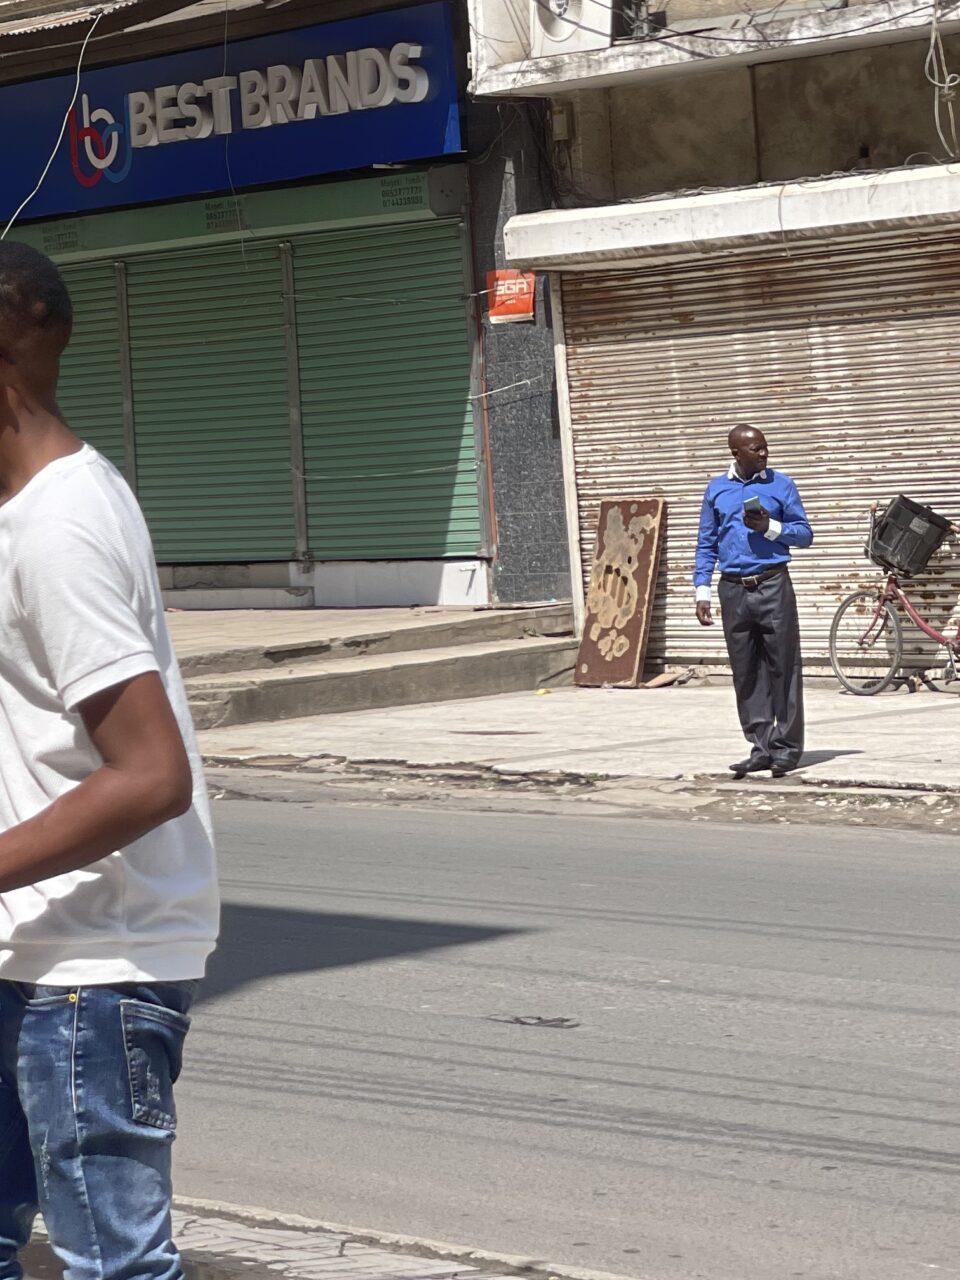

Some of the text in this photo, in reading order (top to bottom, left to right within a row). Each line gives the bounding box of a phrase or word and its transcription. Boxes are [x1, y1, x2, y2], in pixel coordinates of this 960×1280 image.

[128, 75, 238, 149] BEST
[239, 41, 430, 130] BRANDS
[494, 279, 529, 296] SGA
